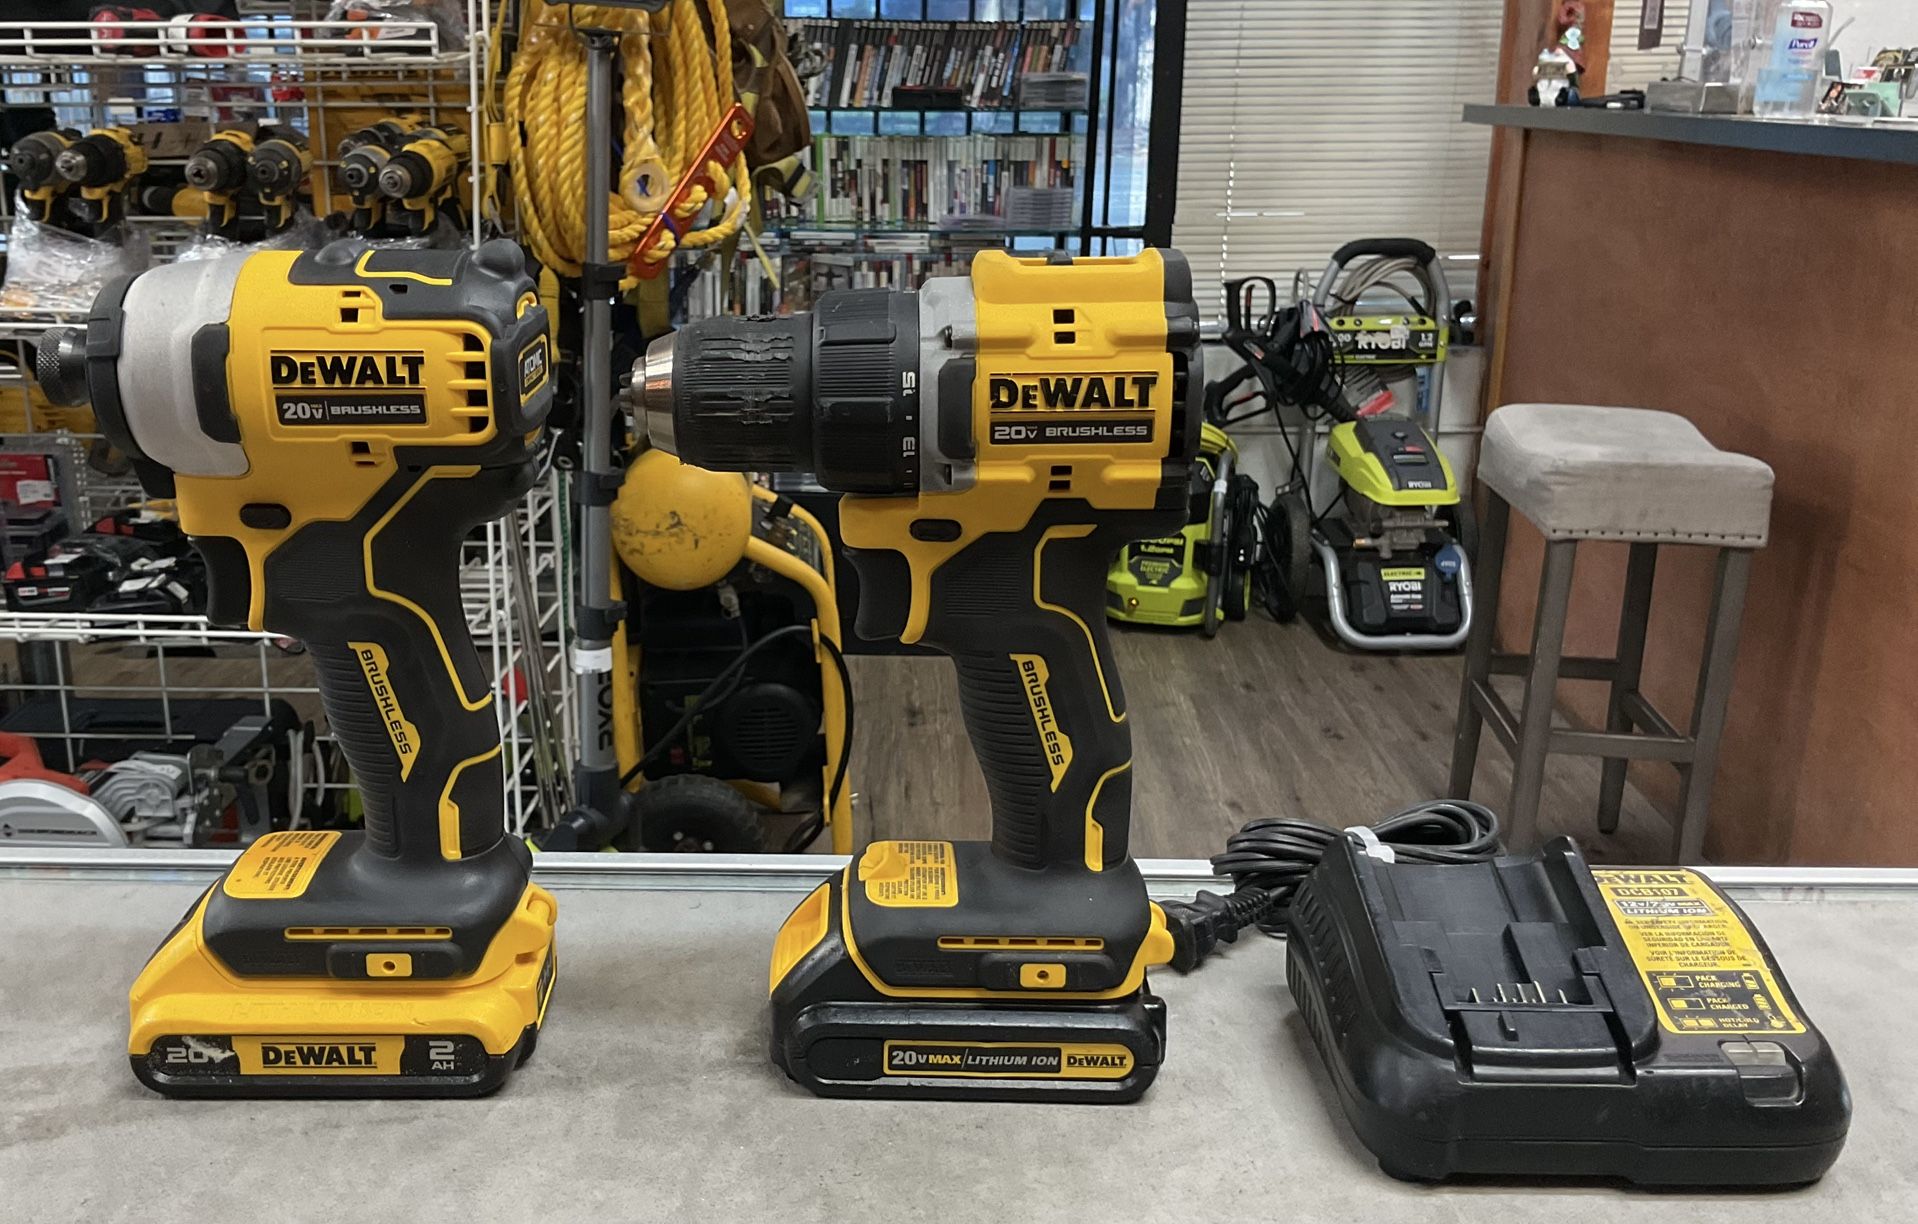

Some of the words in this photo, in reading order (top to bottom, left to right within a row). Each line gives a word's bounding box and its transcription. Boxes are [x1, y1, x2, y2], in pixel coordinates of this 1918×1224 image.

[270, 355, 425, 386] DEWALT
[989, 376, 1159, 409] DEWALT
[282, 402, 323, 419] 20V
[330, 405, 421, 415] BRUSHLESS
[994, 426, 1038, 440] 20V
[1045, 425, 1148, 437] BRUSHLESS
[902, 436, 916, 458] 13
[1388, 581, 1422, 592] RYOBI
[361, 649, 413, 755] BRUSHLESS
[1022, 660, 1065, 766] BRUSHLESS
[1619, 887, 1680, 896] DCB107
[1698, 981, 1742, 989] CHARGING
[261, 1046, 377, 1066] DEWALT
[428, 1040, 455, 1060] 2
[966, 1054, 1028, 1065] LITHIUM
[1031, 1055, 1059, 1066] ION
[1066, 1055, 1128, 1067] DEWALT
